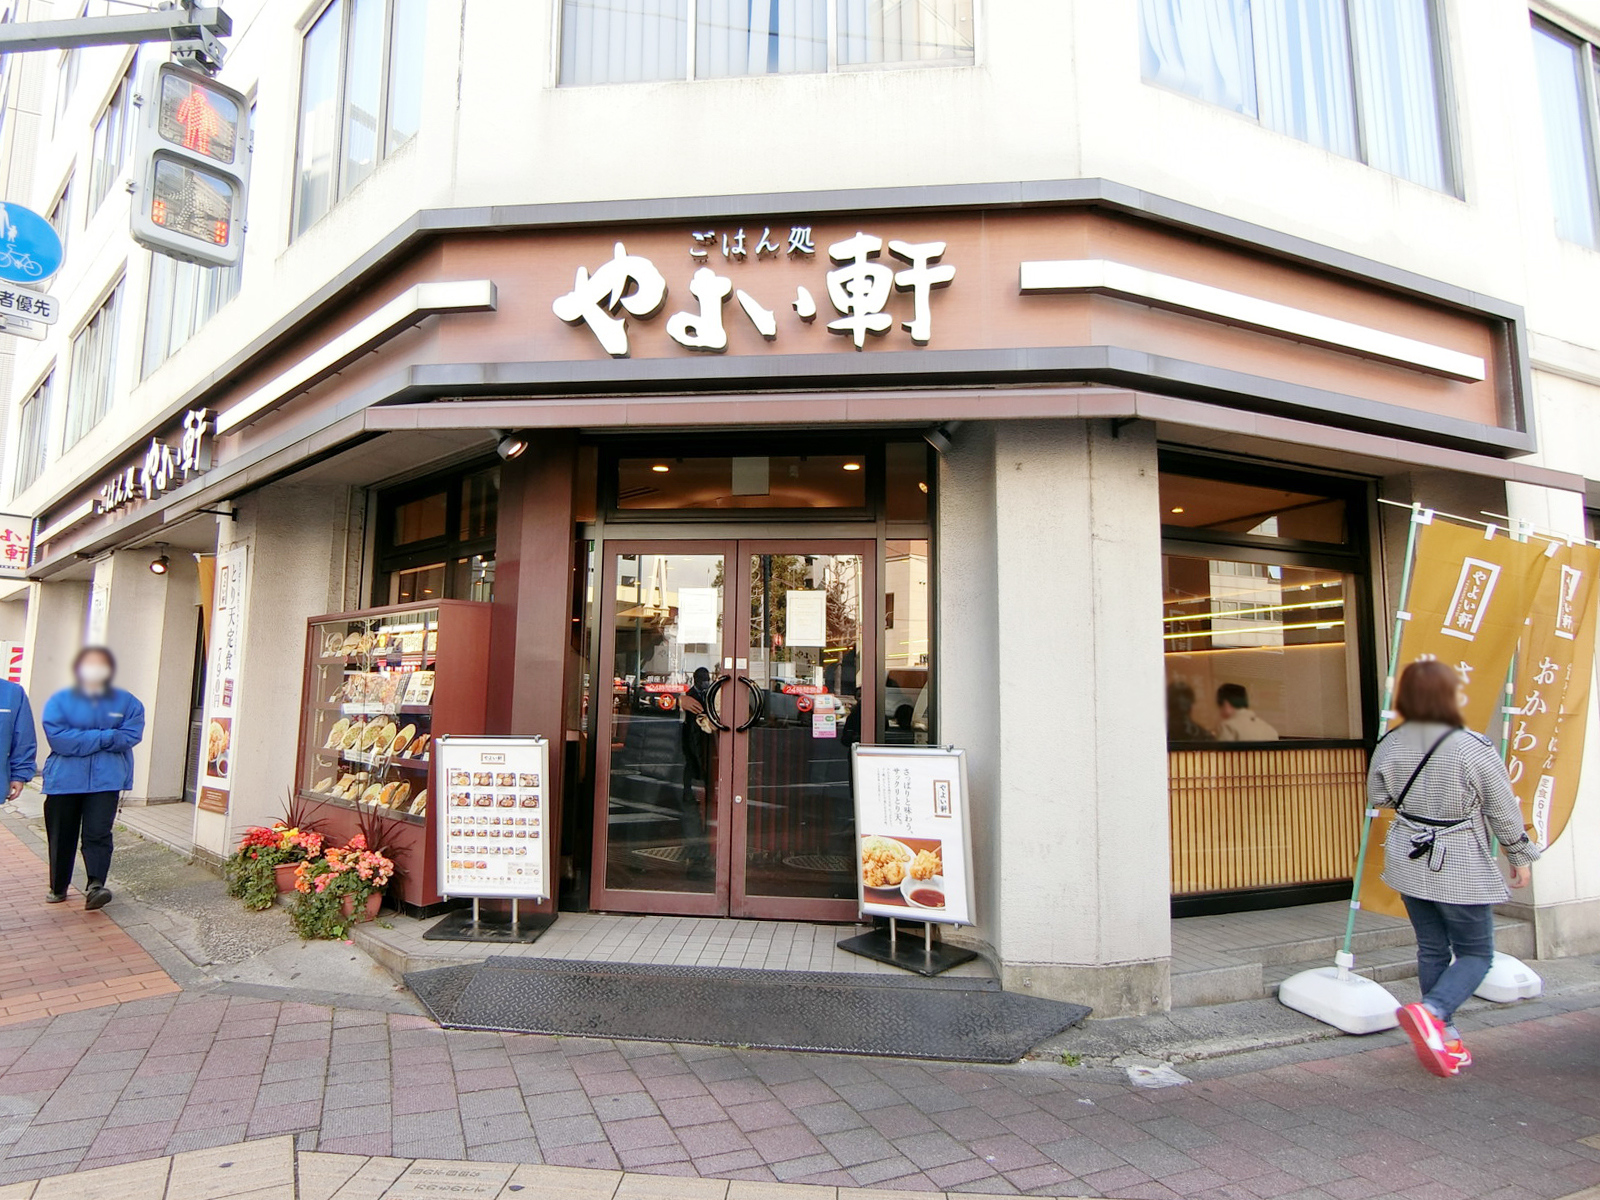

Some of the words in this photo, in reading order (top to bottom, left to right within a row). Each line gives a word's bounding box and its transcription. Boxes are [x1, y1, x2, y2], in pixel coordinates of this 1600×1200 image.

[689, 227, 816, 258] ごはん処
[552, 231, 957, 358] やよい軒
[1456, 571, 1488, 629] やよい軒
[1509, 657, 1559, 806] おかわり
[940, 784, 948, 813] やよい軒
